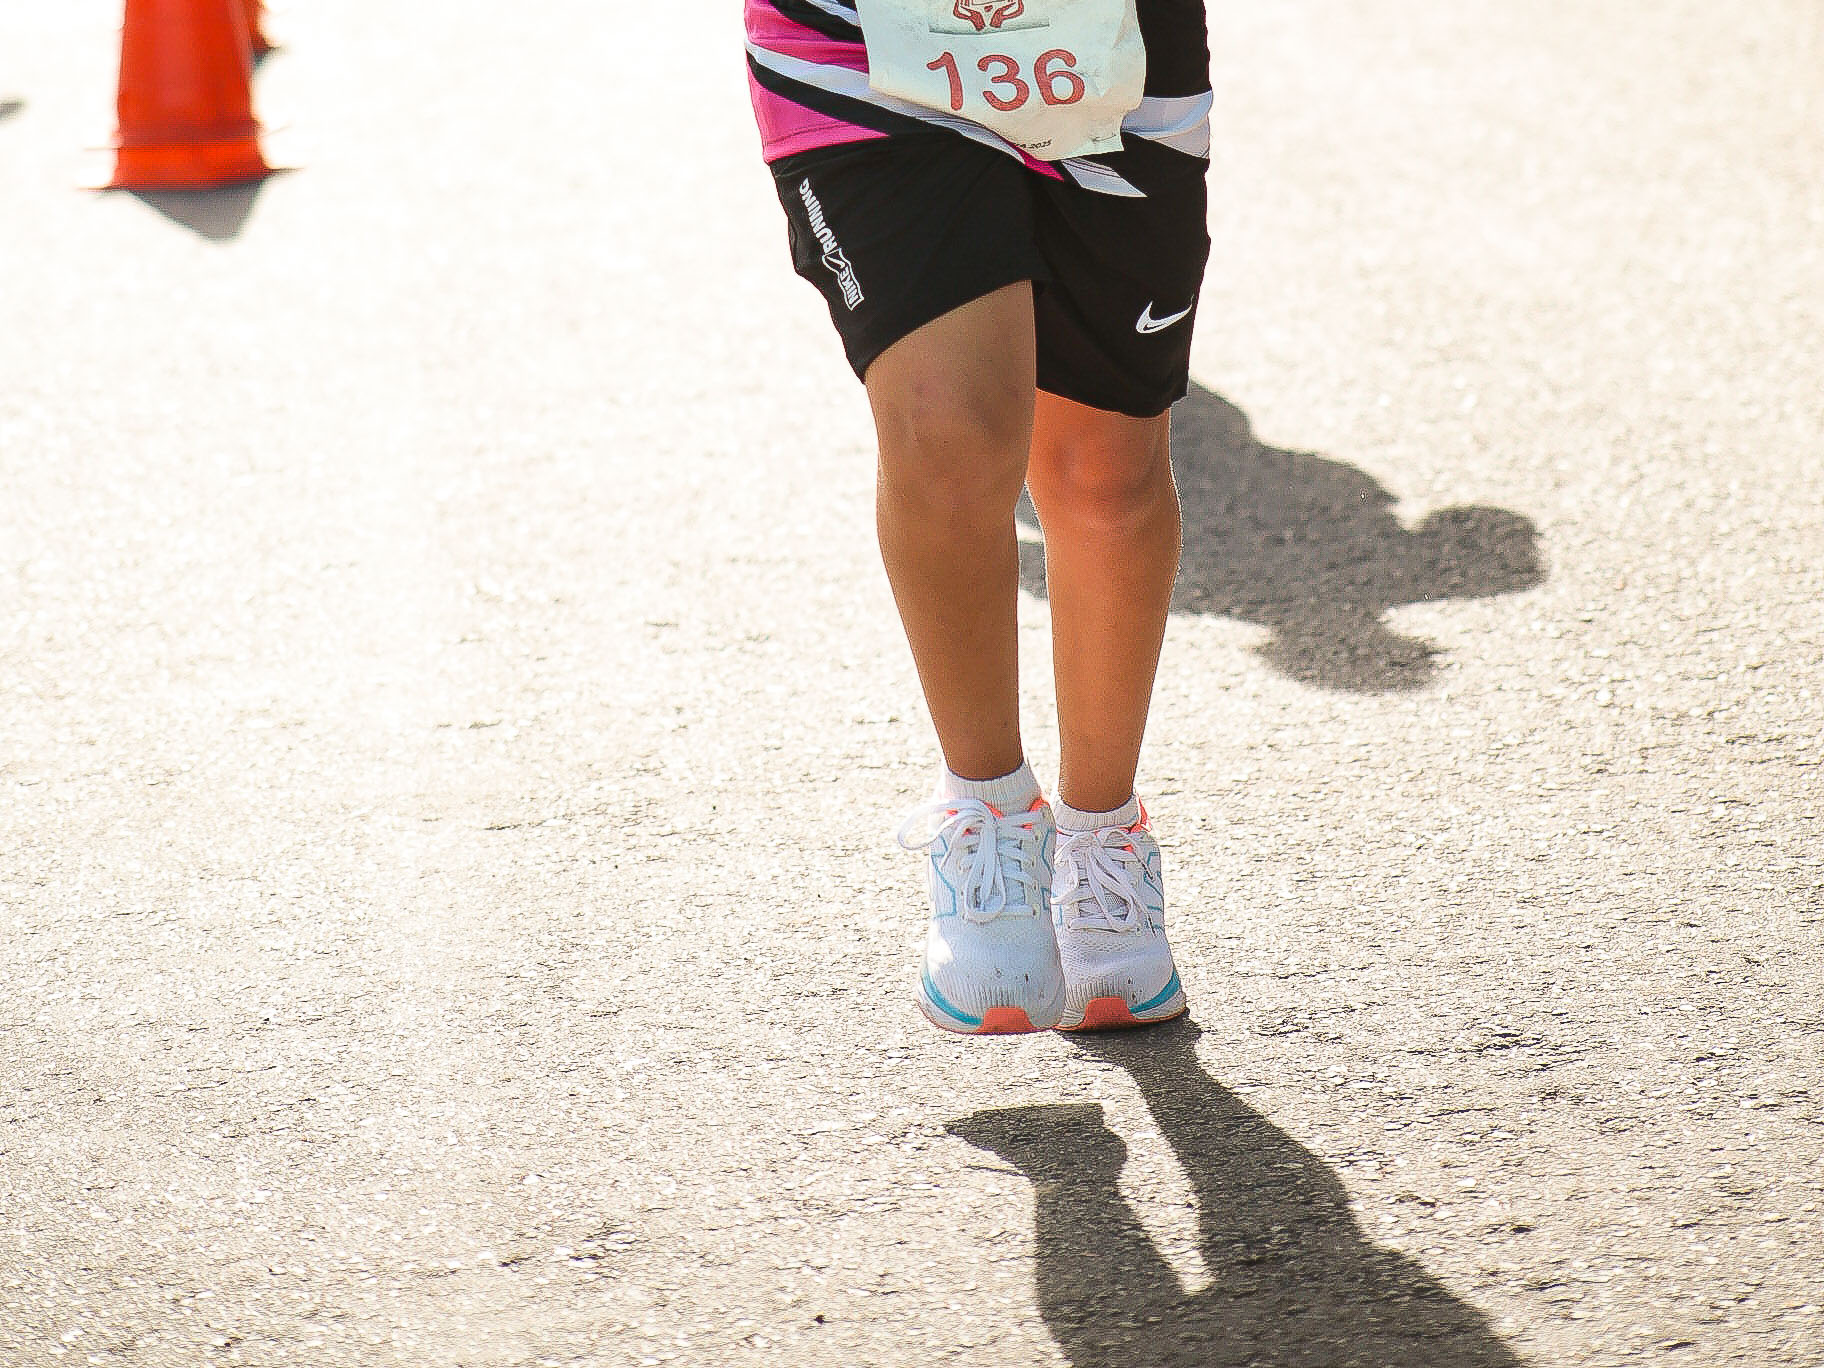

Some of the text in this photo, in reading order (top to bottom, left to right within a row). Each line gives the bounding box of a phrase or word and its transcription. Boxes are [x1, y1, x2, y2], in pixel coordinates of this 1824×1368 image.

[926, 49, 1085, 111] 136
[799, 177, 859, 305] NIKE RUNNING
